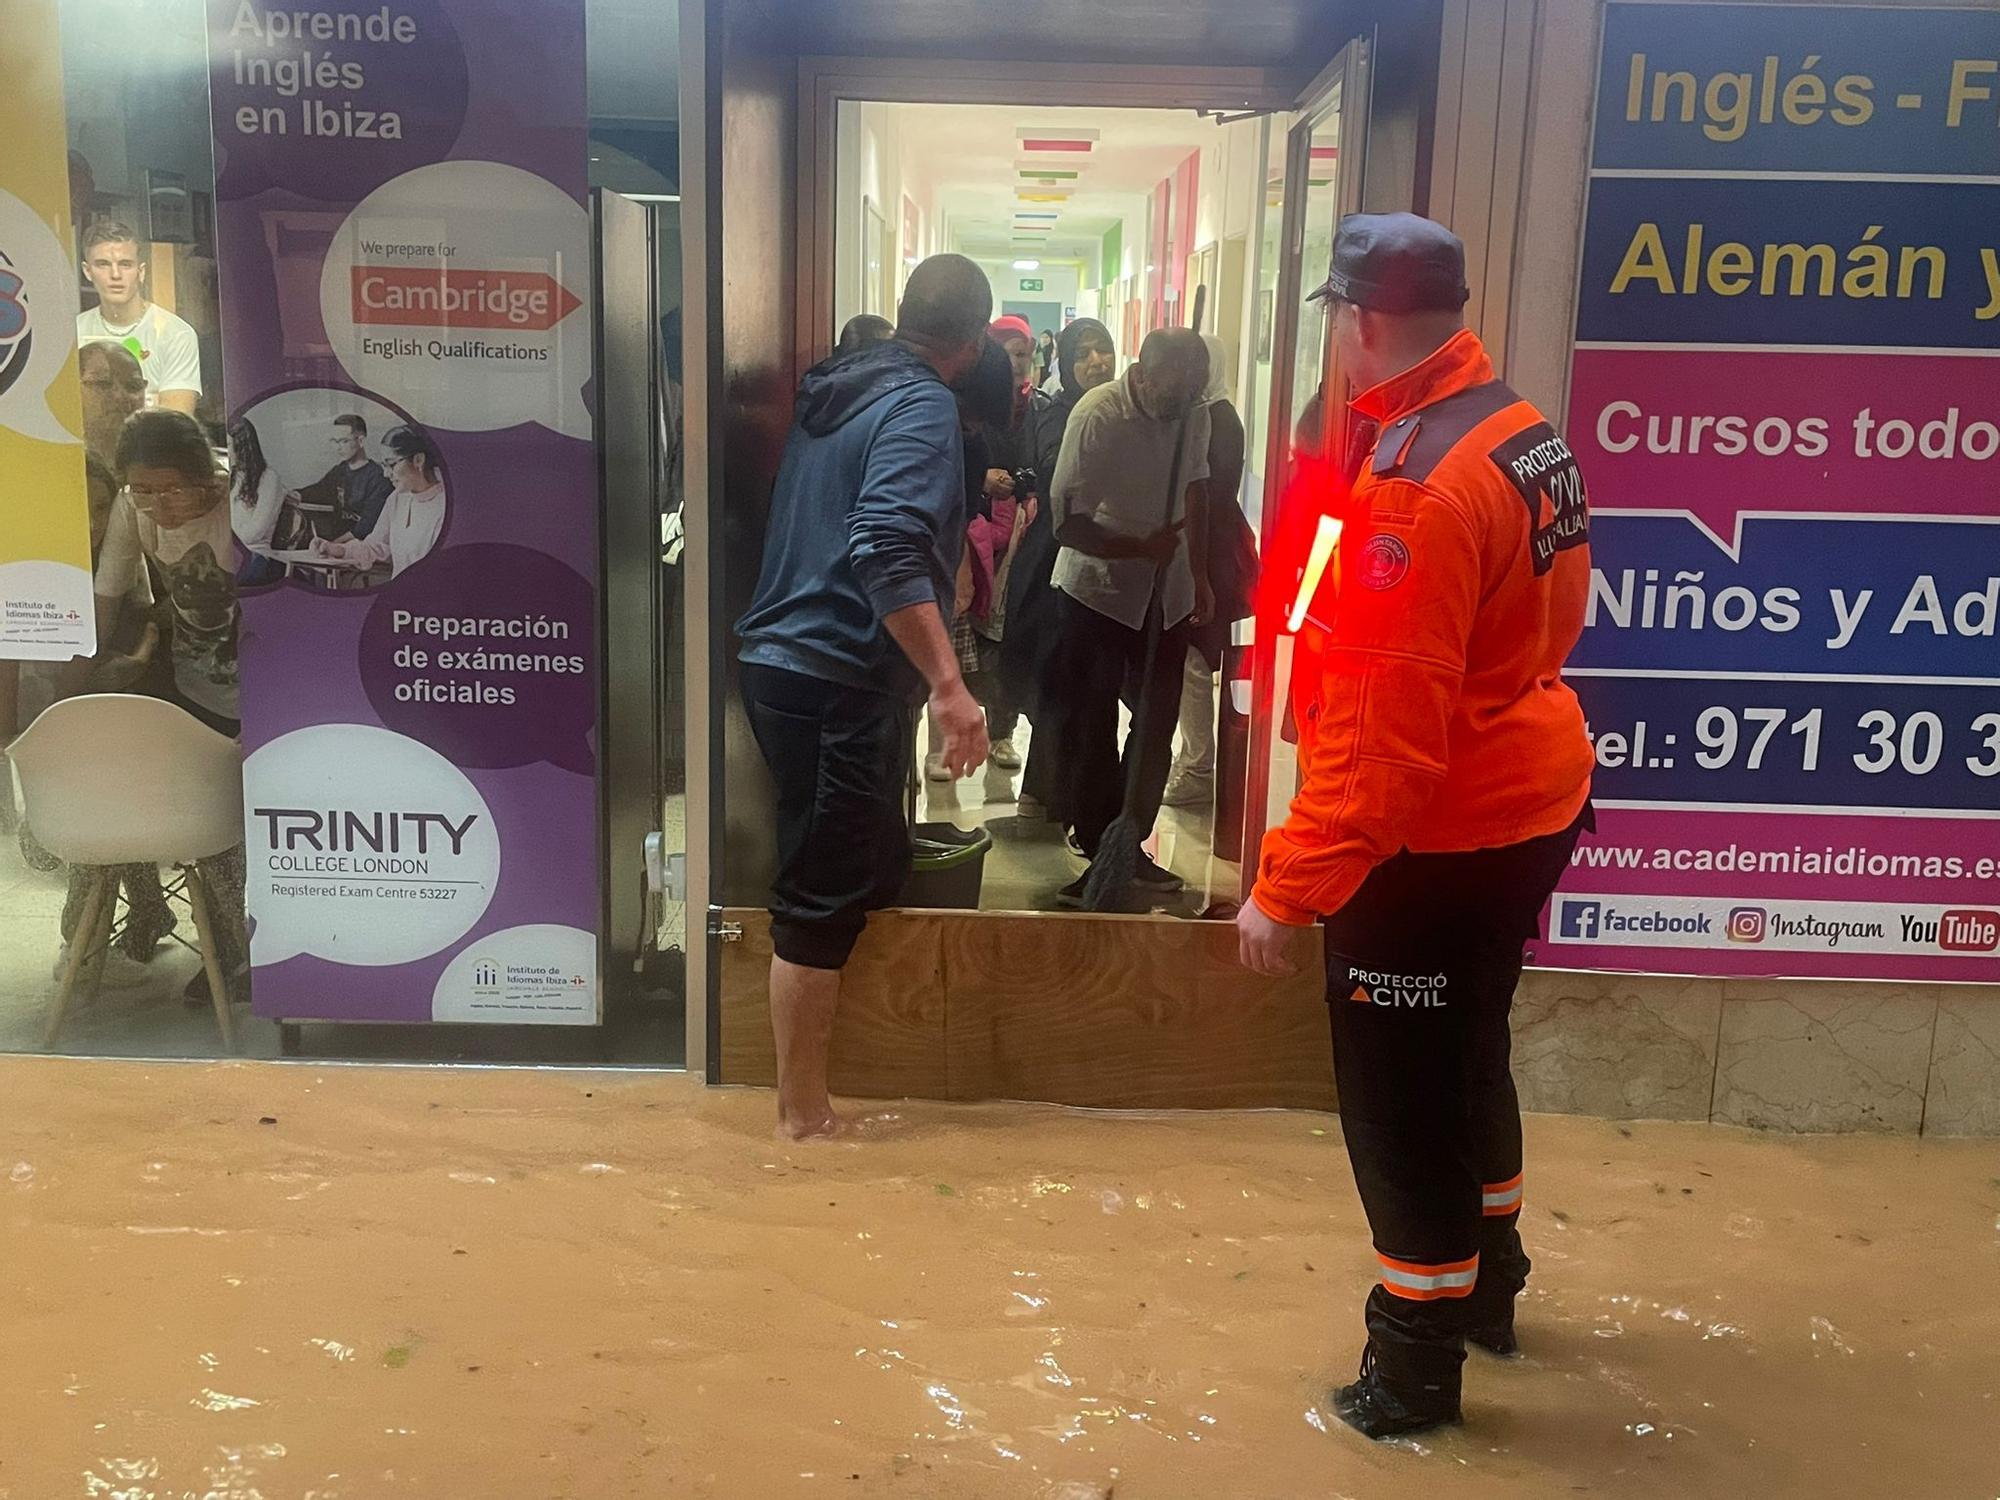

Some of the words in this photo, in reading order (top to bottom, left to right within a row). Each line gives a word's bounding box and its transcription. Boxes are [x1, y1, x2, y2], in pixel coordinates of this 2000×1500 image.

[231, 0, 416, 47] Aprende
[234, 50, 365, 96] Inglés
[1626, 53, 1875, 142] Inglés
[1946, 60, 2000, 128] F
[235, 105, 287, 135] en
[303, 100, 402, 139] Ibiza
[360, 241, 383, 255] We
[386, 244, 438, 258] prepare
[438, 243, 456, 256] for
[1608, 223, 1947, 299] Alemán
[361, 275, 549, 323] Cambridge
[363, 338, 423, 359] English
[428, 341, 548, 360] Qualifications
[1597, 400, 1830, 458] Cursos
[1853, 407, 2000, 461] todo
[44, 602, 56, 610] de
[1584, 567, 1801, 633] Niños
[1826, 588, 1874, 650] y
[1889, 575, 2000, 637] Ad
[393, 610, 569, 641] Preparación
[393, 645, 429, 668] de
[437, 647, 585, 673] exámenes
[394, 678, 516, 705] oficiales
[1695, 706, 1823, 771] 971
[1853, 709, 1944, 775] 30
[1966, 712, 2000, 777] 3
[254, 808, 479, 856] TRINITY
[268, 855, 349, 872] COLLEGE
[353, 858, 429, 874] LONDON
[271, 884, 336, 898] Registered
[340, 886, 373, 898] Exam
[376, 887, 417, 899] Centre
[420, 888, 457, 900] 53227
[1604, 908, 1713, 934] facebook
[1770, 913, 1885, 947] Instagram
[507, 965, 547, 975] Instituto
[548, 967, 560, 975] de
[507, 975, 544, 984] Idiomas
[546, 976, 568, 985] Ibiza
[1348, 967, 1447, 989] PROTECCIÓ
[1372, 987, 1448, 1008] CIVIL
